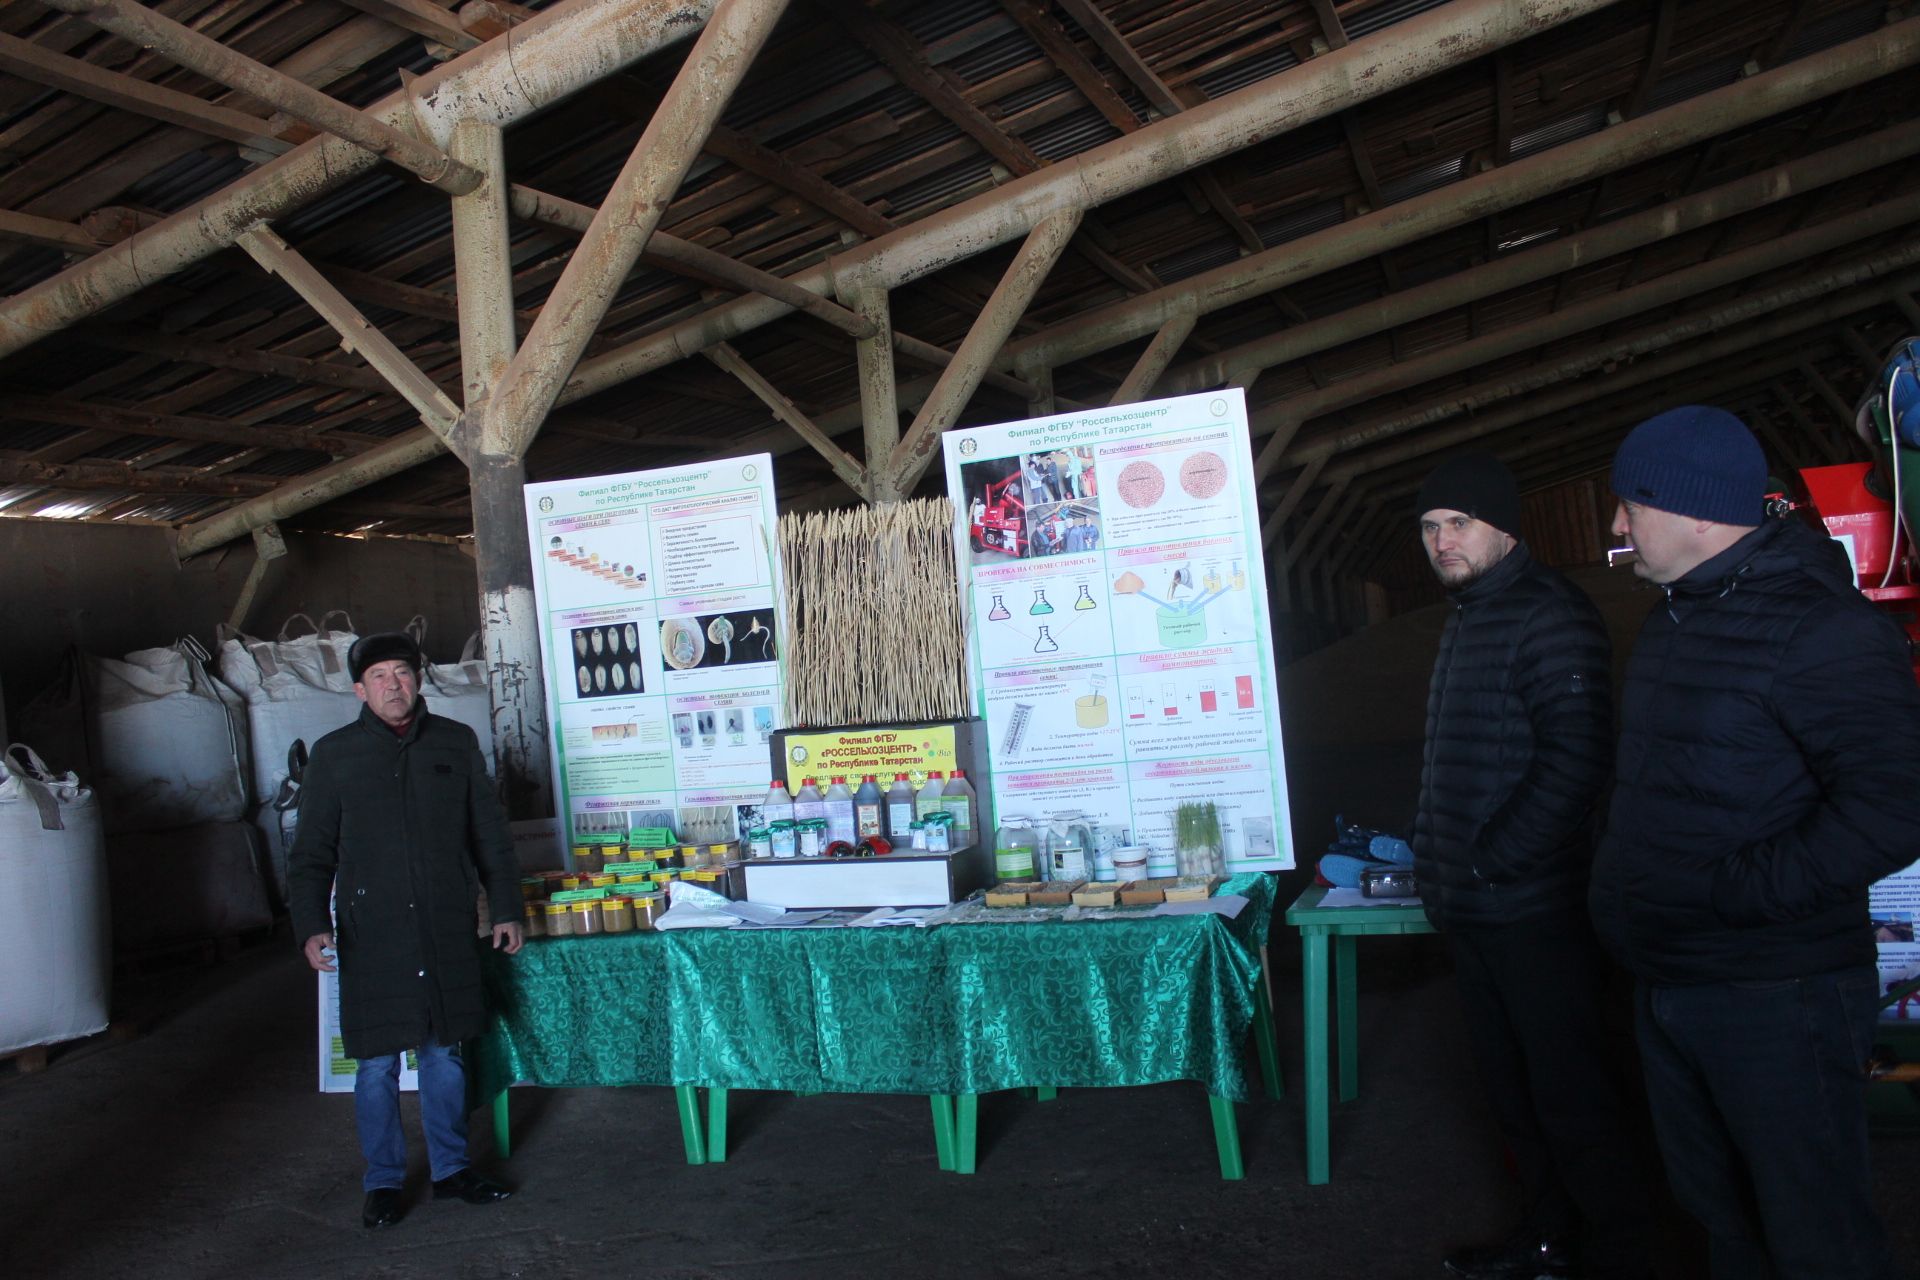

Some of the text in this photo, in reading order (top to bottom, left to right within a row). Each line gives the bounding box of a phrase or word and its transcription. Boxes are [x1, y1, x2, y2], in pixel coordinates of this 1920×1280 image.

[1008, 427, 1045, 438] Филиал
[1048, 421, 1074, 432] ФГБУ
[1029, 422, 1152, 447] по Республике Татарстан
[578, 487, 608, 497] Филиал
[611, 483, 632, 492] ФГБУ
[608, 491, 653, 504] Республике
[656, 485, 695, 496] Татарстан
[978, 568, 1015, 577] ПРОВЕРКА
[1029, 557, 1097, 571] СОВМЕСТИМОСТЬ
[1173, 650, 1199, 659] суммы
[839, 734, 897, 745] Филиал ФГБУ
[821, 744, 917, 757] «РОССЕЛЬХОЗЦЕНТР»
[830, 759, 879, 769] Республике
[881, 756, 924, 766] Татарстан
